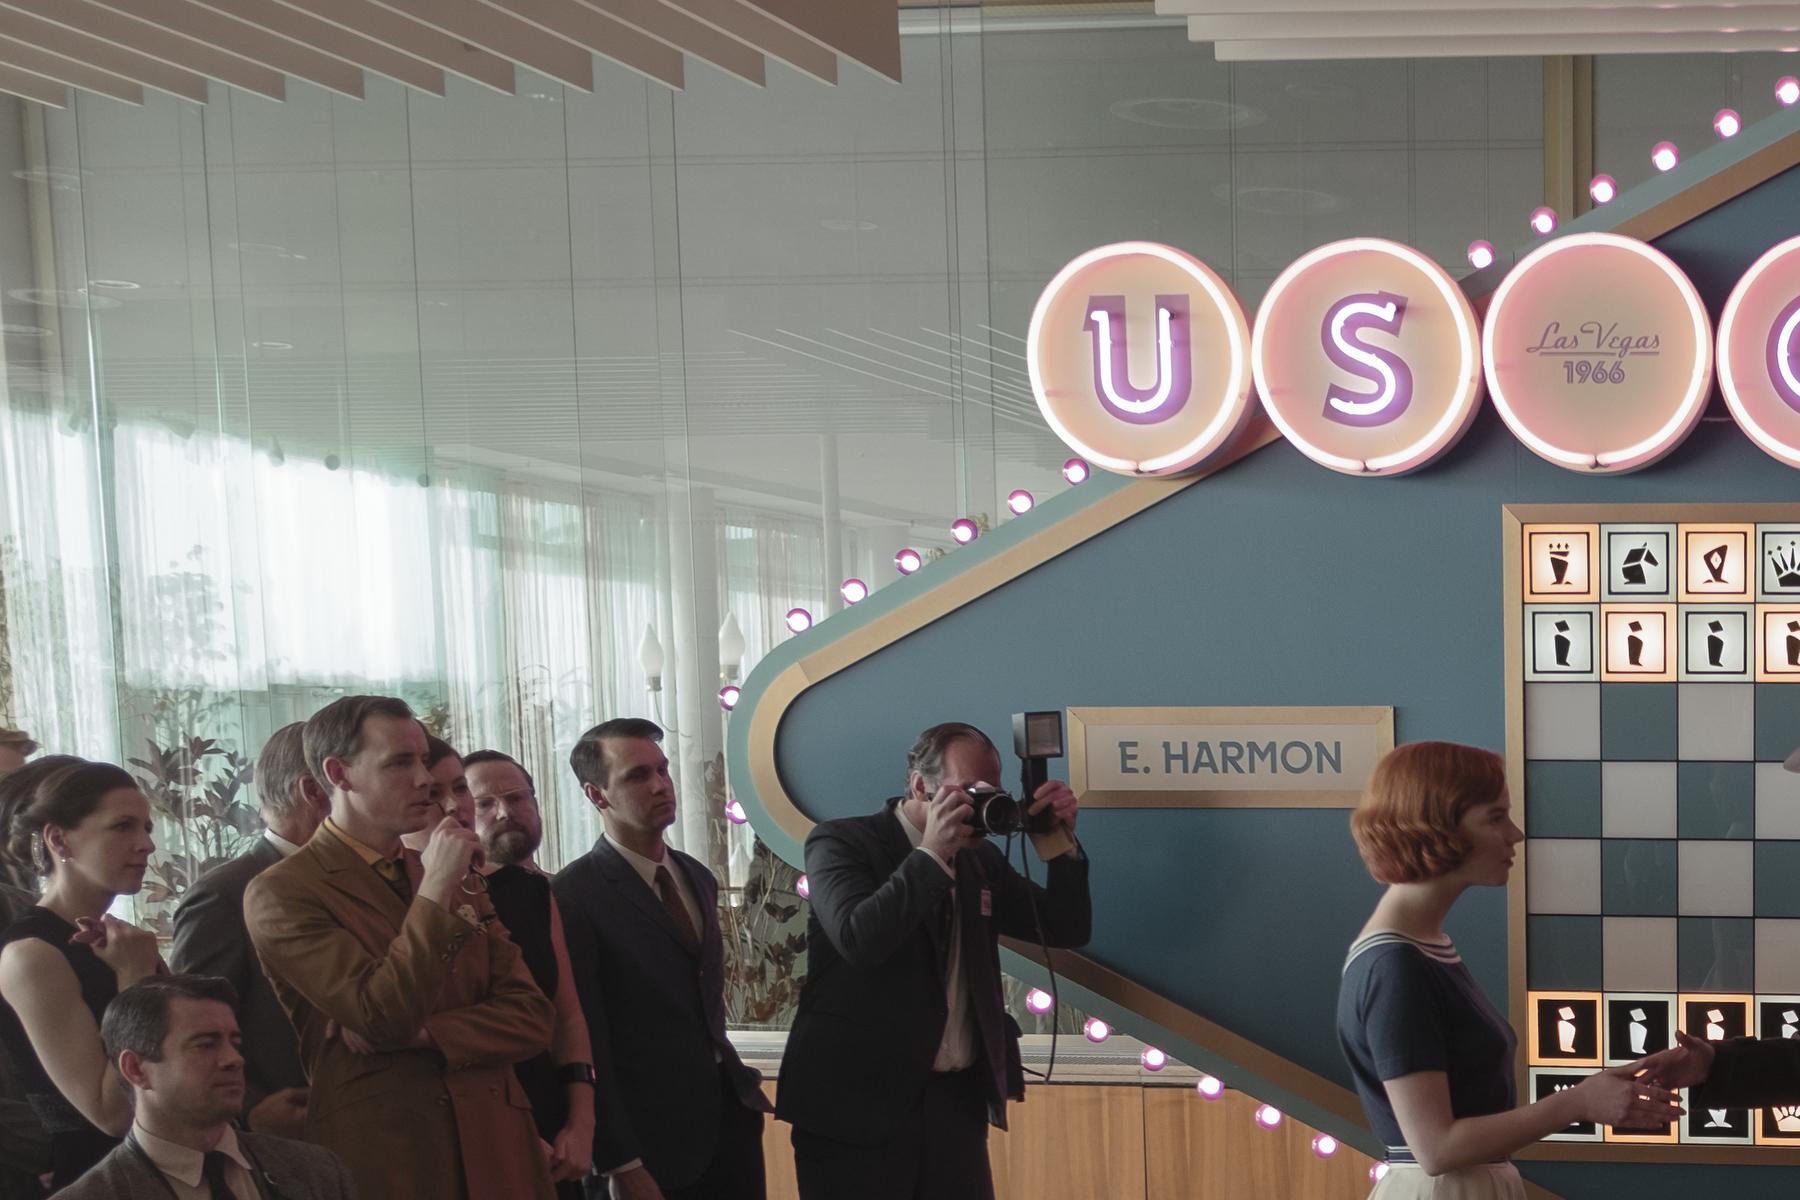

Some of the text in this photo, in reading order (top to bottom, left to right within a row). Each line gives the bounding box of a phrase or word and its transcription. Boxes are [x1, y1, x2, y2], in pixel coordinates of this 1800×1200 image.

[1526, 321, 1661, 358] Las Vegas
[1563, 360, 1625, 384] 1966
[1118, 740, 1342, 775] E. HARMON
